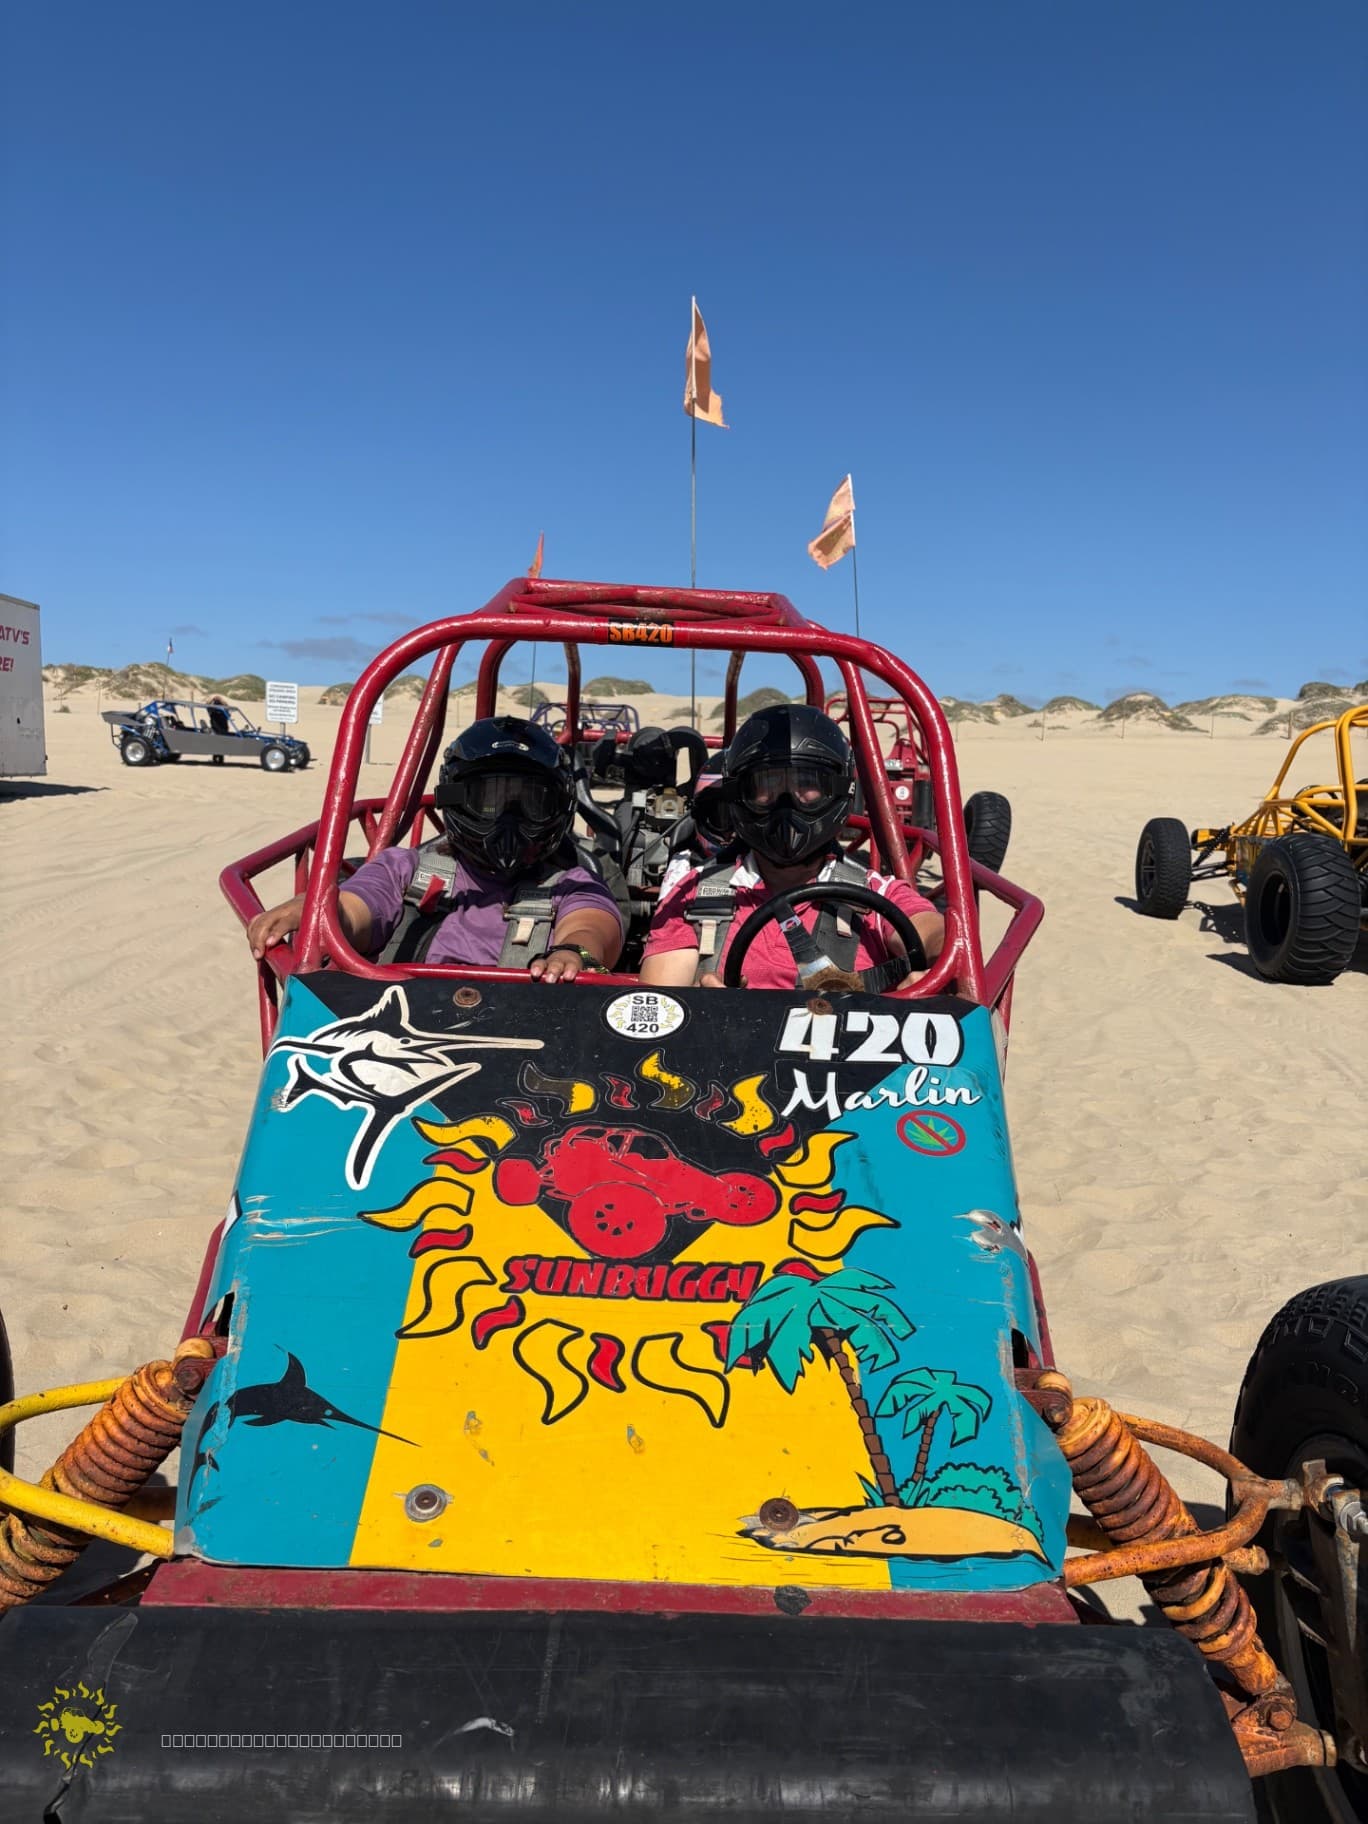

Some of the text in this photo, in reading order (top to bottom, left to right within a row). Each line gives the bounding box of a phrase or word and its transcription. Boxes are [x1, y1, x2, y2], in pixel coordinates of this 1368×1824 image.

[609, 622, 673, 644] SB420
[0, 655, 14, 673] E!
[632, 995, 658, 1005] SB
[626, 1023, 659, 1033] 420
[779, 1007, 961, 1066] 420
[780, 1065, 982, 1121] Marlin
[502, 1256, 763, 1301] SUNBUGGY
